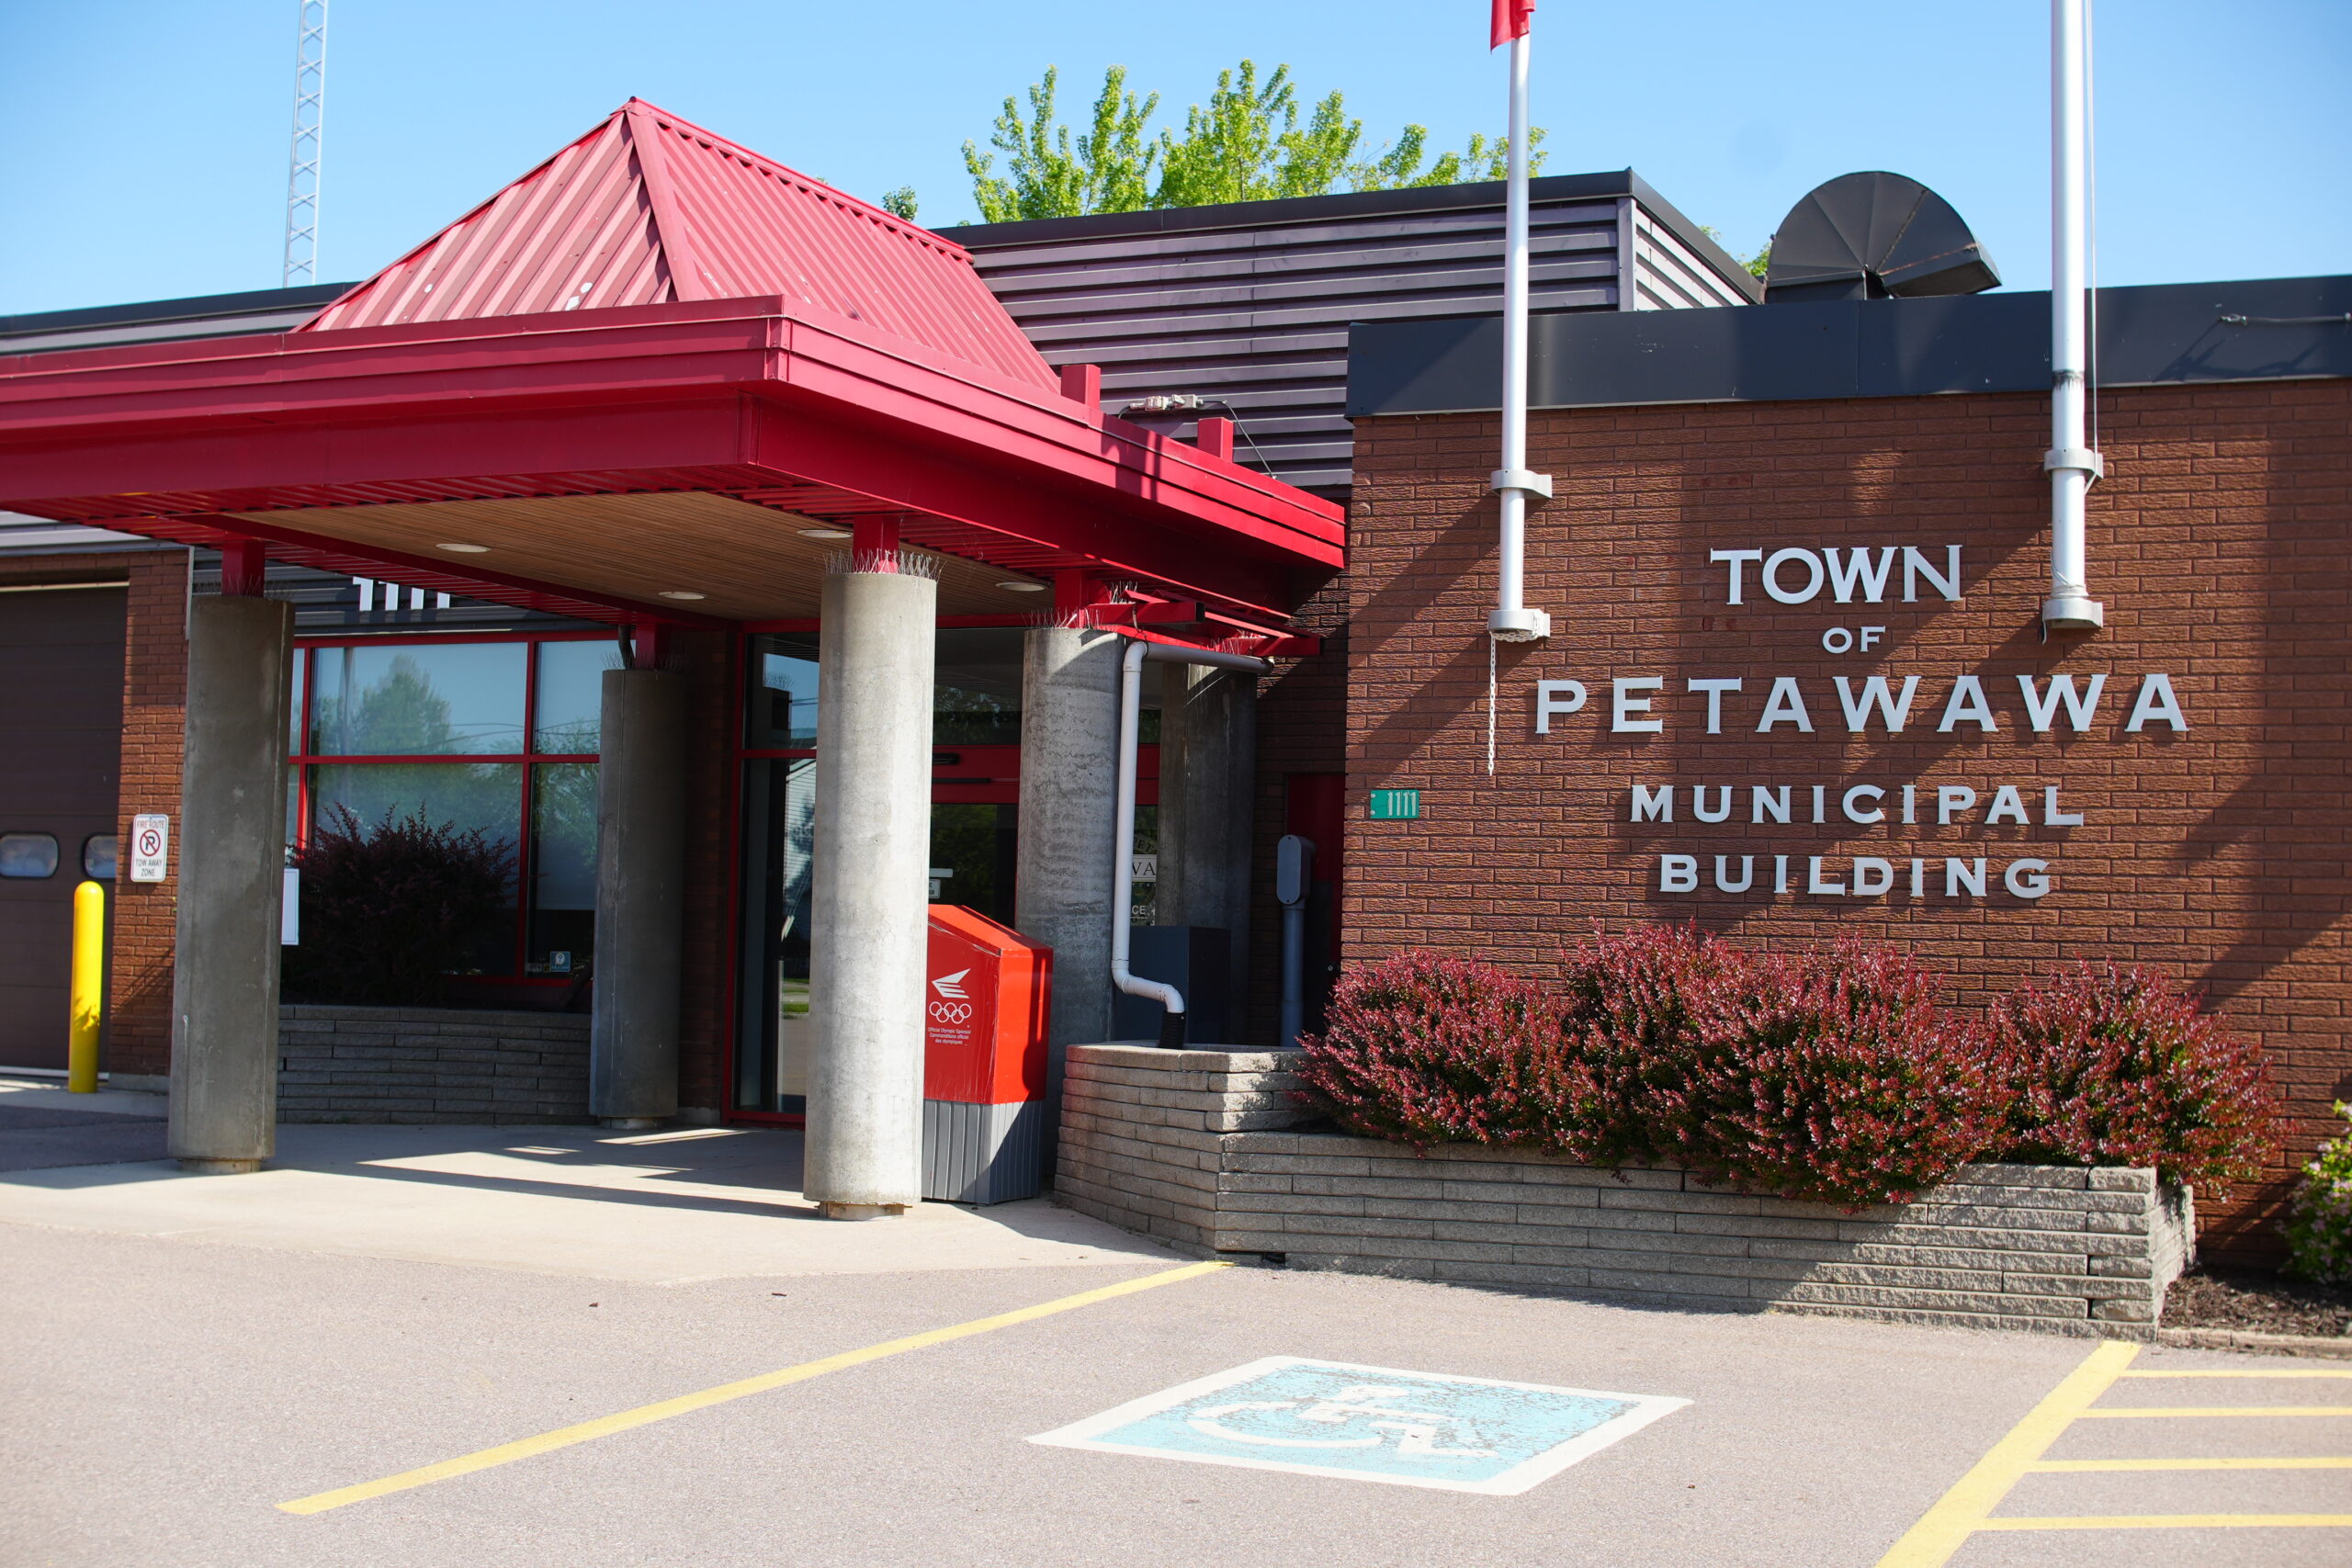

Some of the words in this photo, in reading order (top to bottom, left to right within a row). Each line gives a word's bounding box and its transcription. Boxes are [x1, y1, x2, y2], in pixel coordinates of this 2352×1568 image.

[1710, 544, 1964, 605] TOWN
[1822, 625, 1886, 654] OF
[1534, 672, 2191, 735] PETAWAWA
[1387, 792, 1417, 817] 1111
[1630, 783, 2086, 828] MUNICIPAL
[137, 820, 148, 829] FIRE
[149, 820, 164, 829] ROUTE
[135, 859, 147, 867] TOW
[148, 859, 163, 867] AWAY
[141, 869, 154, 877] ZONE
[1657, 853, 2052, 898] BUILDING
